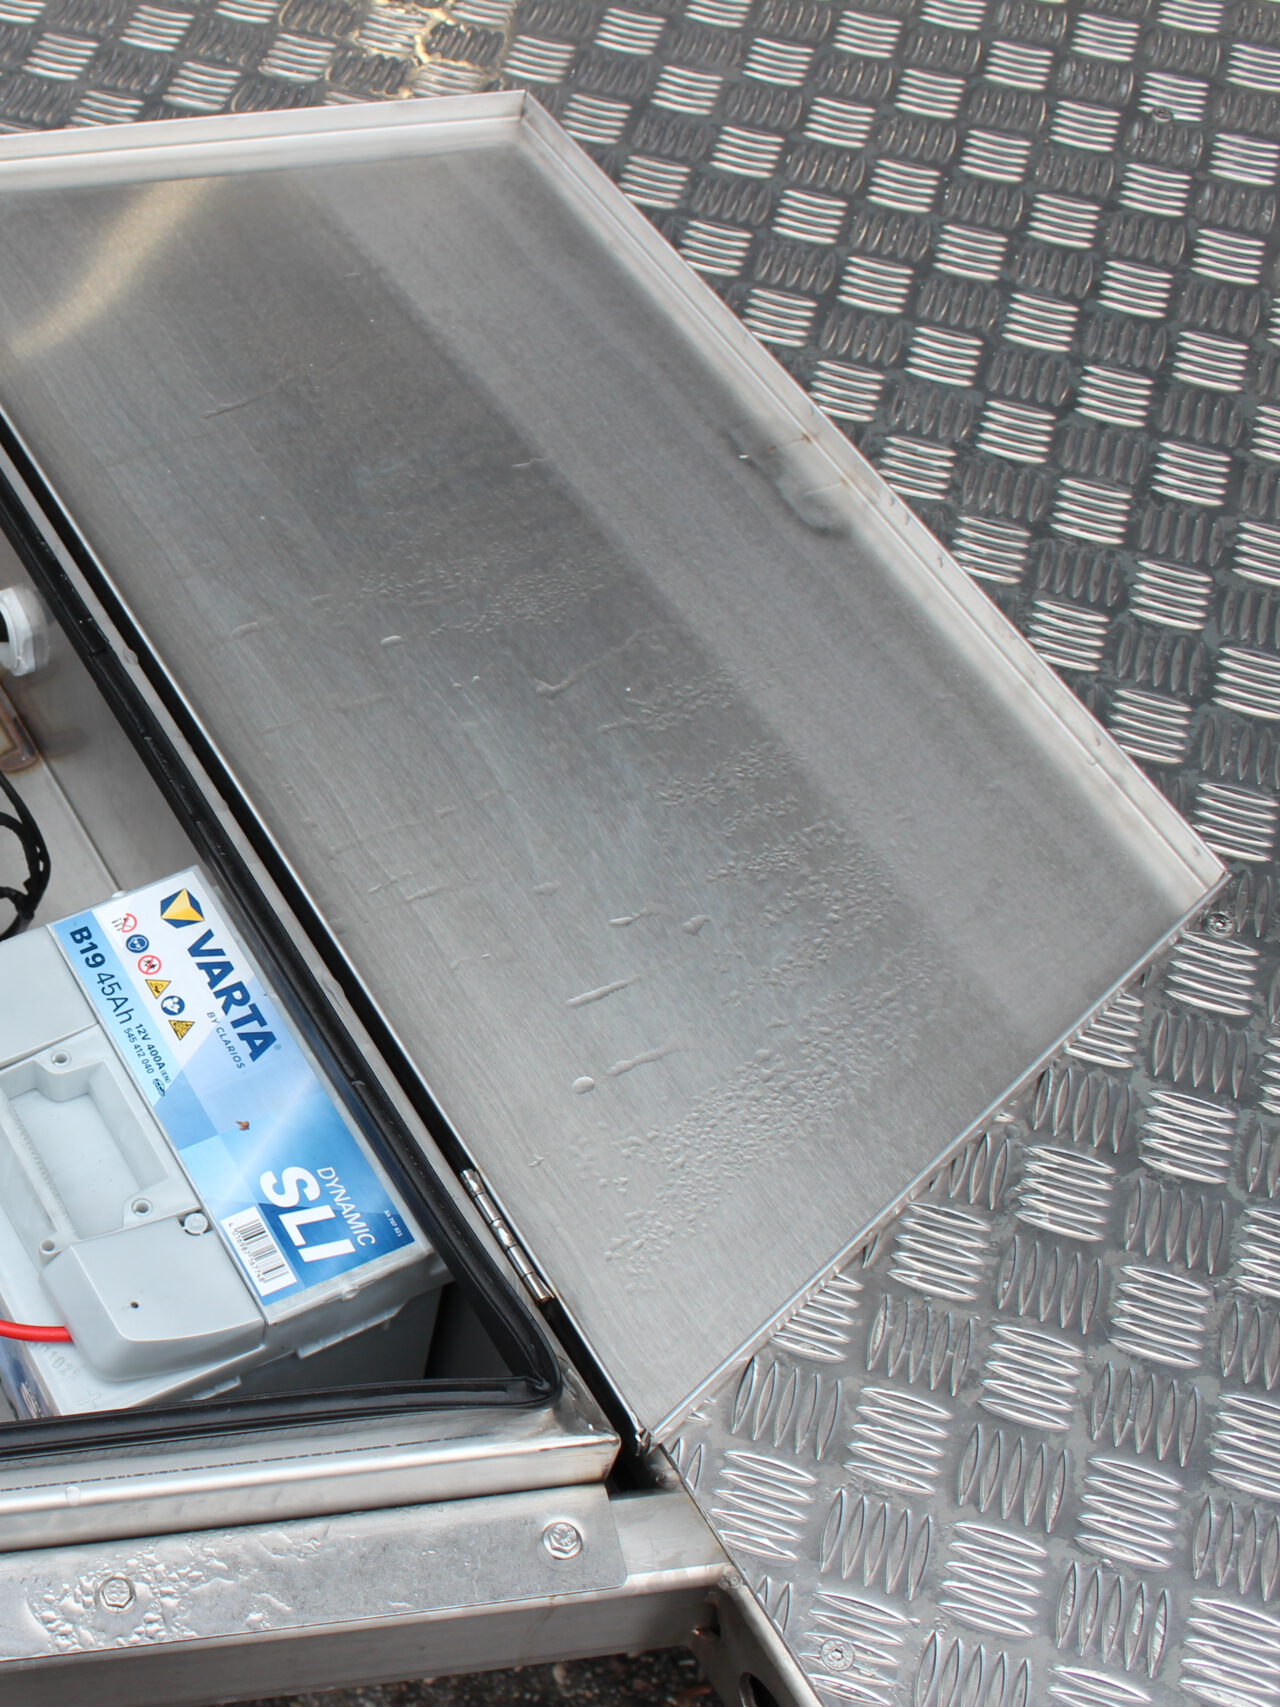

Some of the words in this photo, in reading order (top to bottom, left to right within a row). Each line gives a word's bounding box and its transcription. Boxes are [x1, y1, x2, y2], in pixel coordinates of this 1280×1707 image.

[69, 926, 106, 969] B19
[97, 972, 134, 1025] 45Ah
[187, 928, 277, 1062] VARTA
[124, 1027, 138, 1043] 545
[133, 1044, 146, 1058] 412
[141, 1058, 155, 1074] 040
[135, 1023, 151, 1041] 12V
[207, 1011, 219, 1024] BY
[216, 1027, 246, 1069] CLARIOS
[259, 1166, 357, 1263] SLI
[317, 1166, 376, 1247] DYNAMIC
